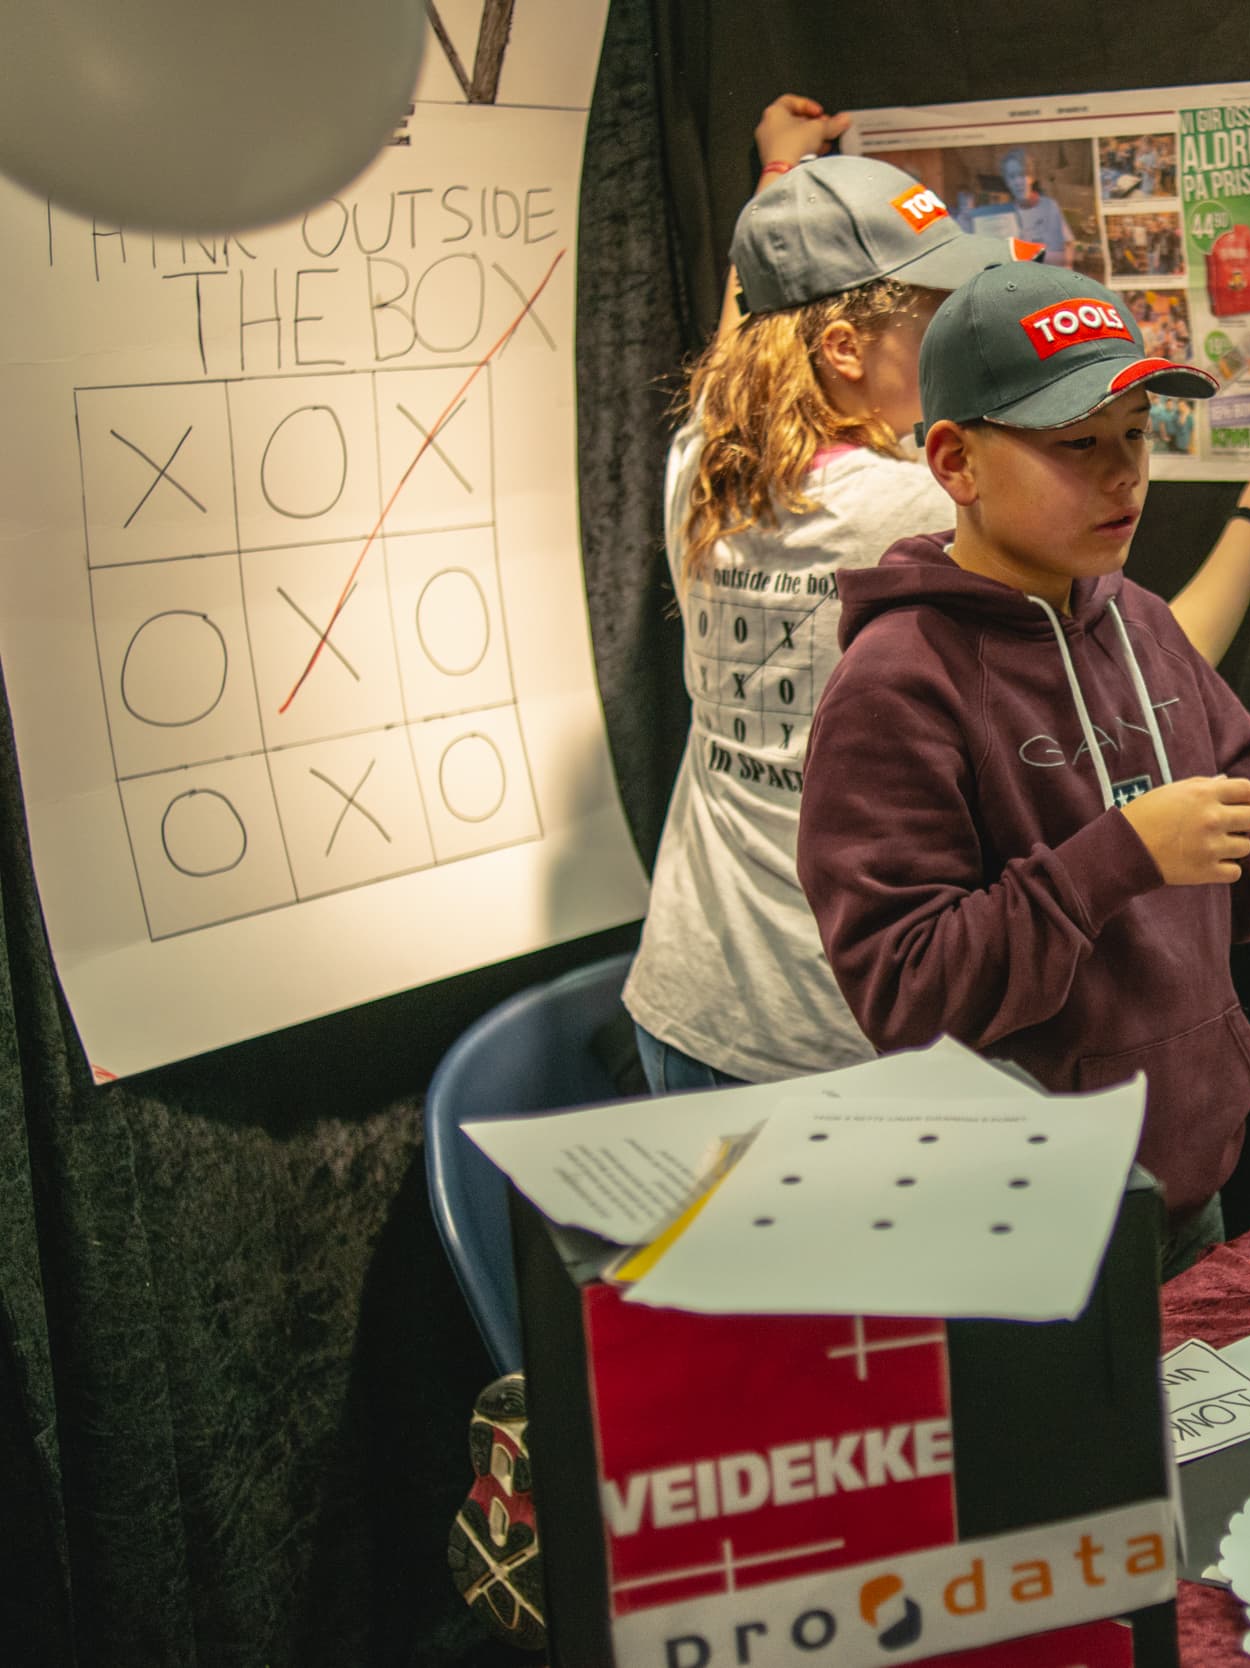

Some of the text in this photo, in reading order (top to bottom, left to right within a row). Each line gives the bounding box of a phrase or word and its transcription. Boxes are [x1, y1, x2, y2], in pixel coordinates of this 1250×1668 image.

[301, 185, 560, 259] OUTSIDE
[162, 251, 561, 376] THE BOX
[1033, 305, 1124, 342] TOOLS
[110, 426, 207, 530] X
[714, 567, 771, 592] outside
[774, 571, 801, 595] the
[309, 757, 391, 857] X
[603, 1418, 954, 1538] VEIDEKKE
[665, 1531, 1167, 1668] pro data
